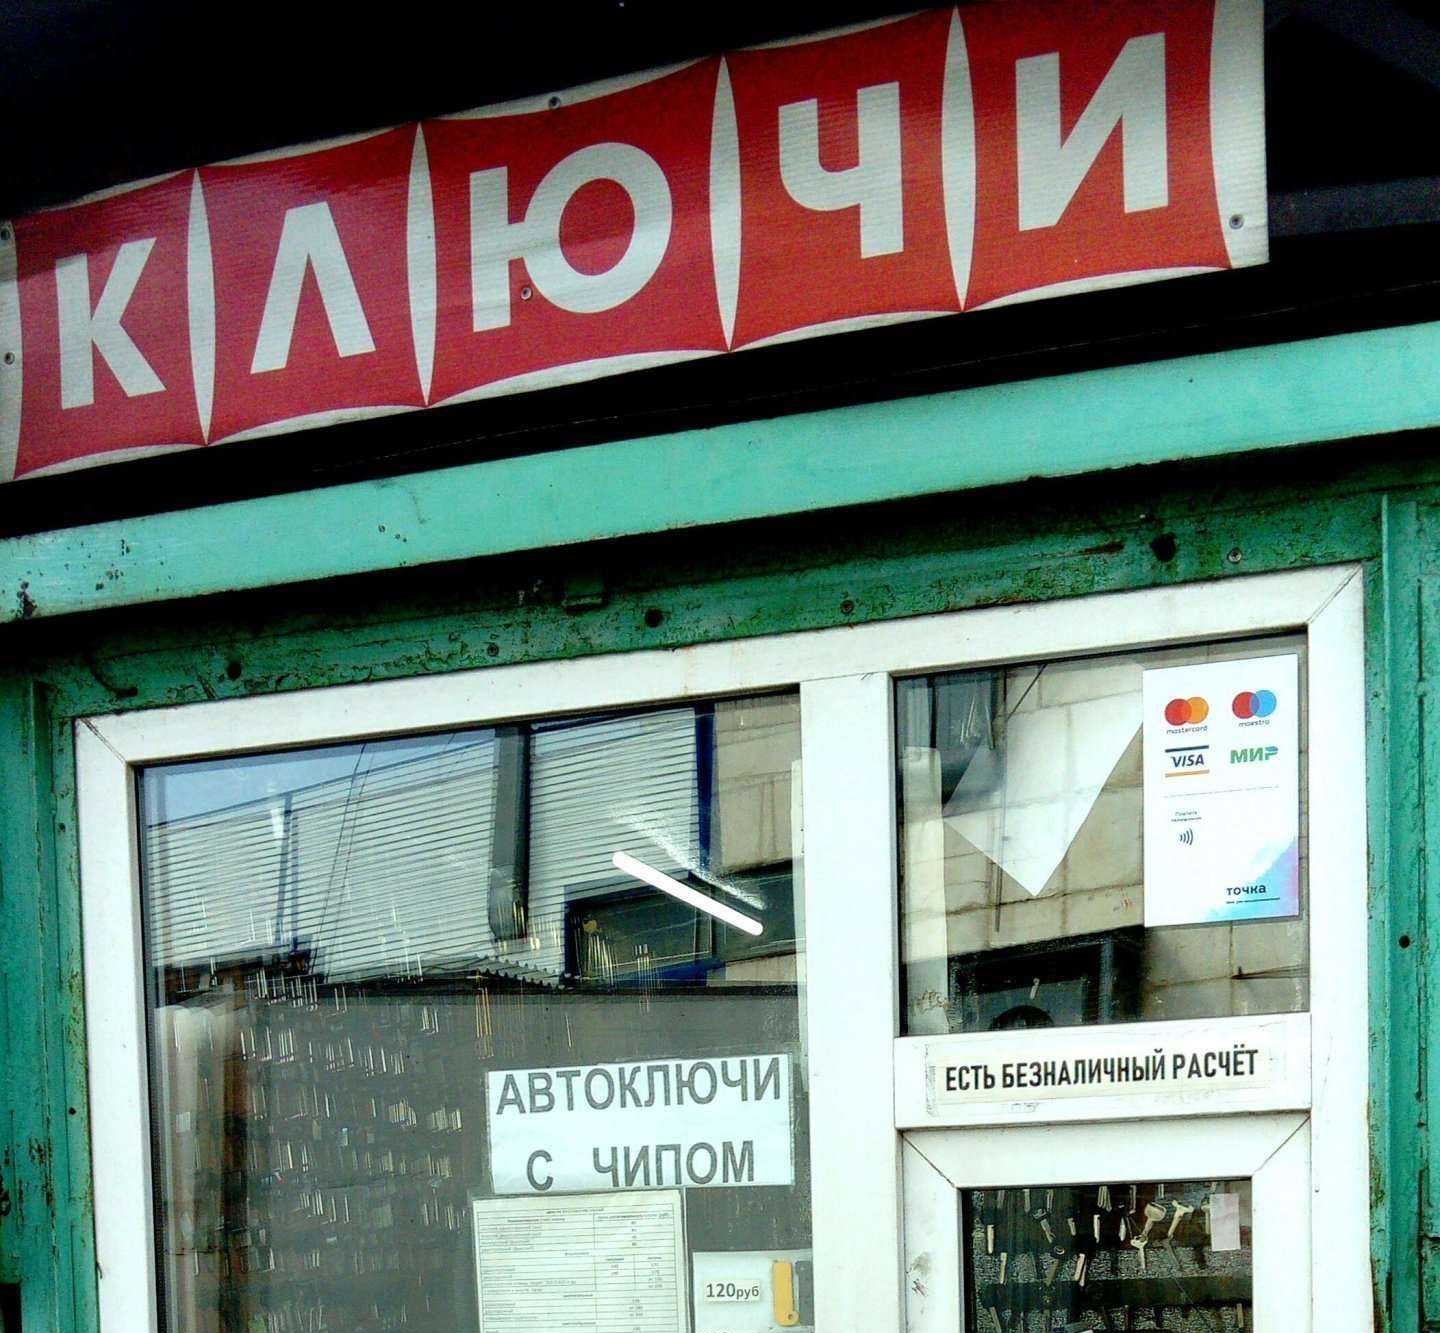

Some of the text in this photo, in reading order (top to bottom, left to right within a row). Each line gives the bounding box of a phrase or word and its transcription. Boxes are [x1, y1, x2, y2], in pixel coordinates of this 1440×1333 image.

[54, 31, 1170, 410] КЛЮЧИ
[1171, 754, 1205, 768] VISA
[1230, 746, 1279, 765] МИР
[1226, 884, 1266, 896] точка
[496, 1057, 780, 1115] АВТОКЛЮЧИ
[945, 1044, 1259, 1091] ЕСТЬ БЕЗНАЛИЧНЫЙ РАСЧЁТ
[526, 1140, 755, 1191] С ЧИПОМ
